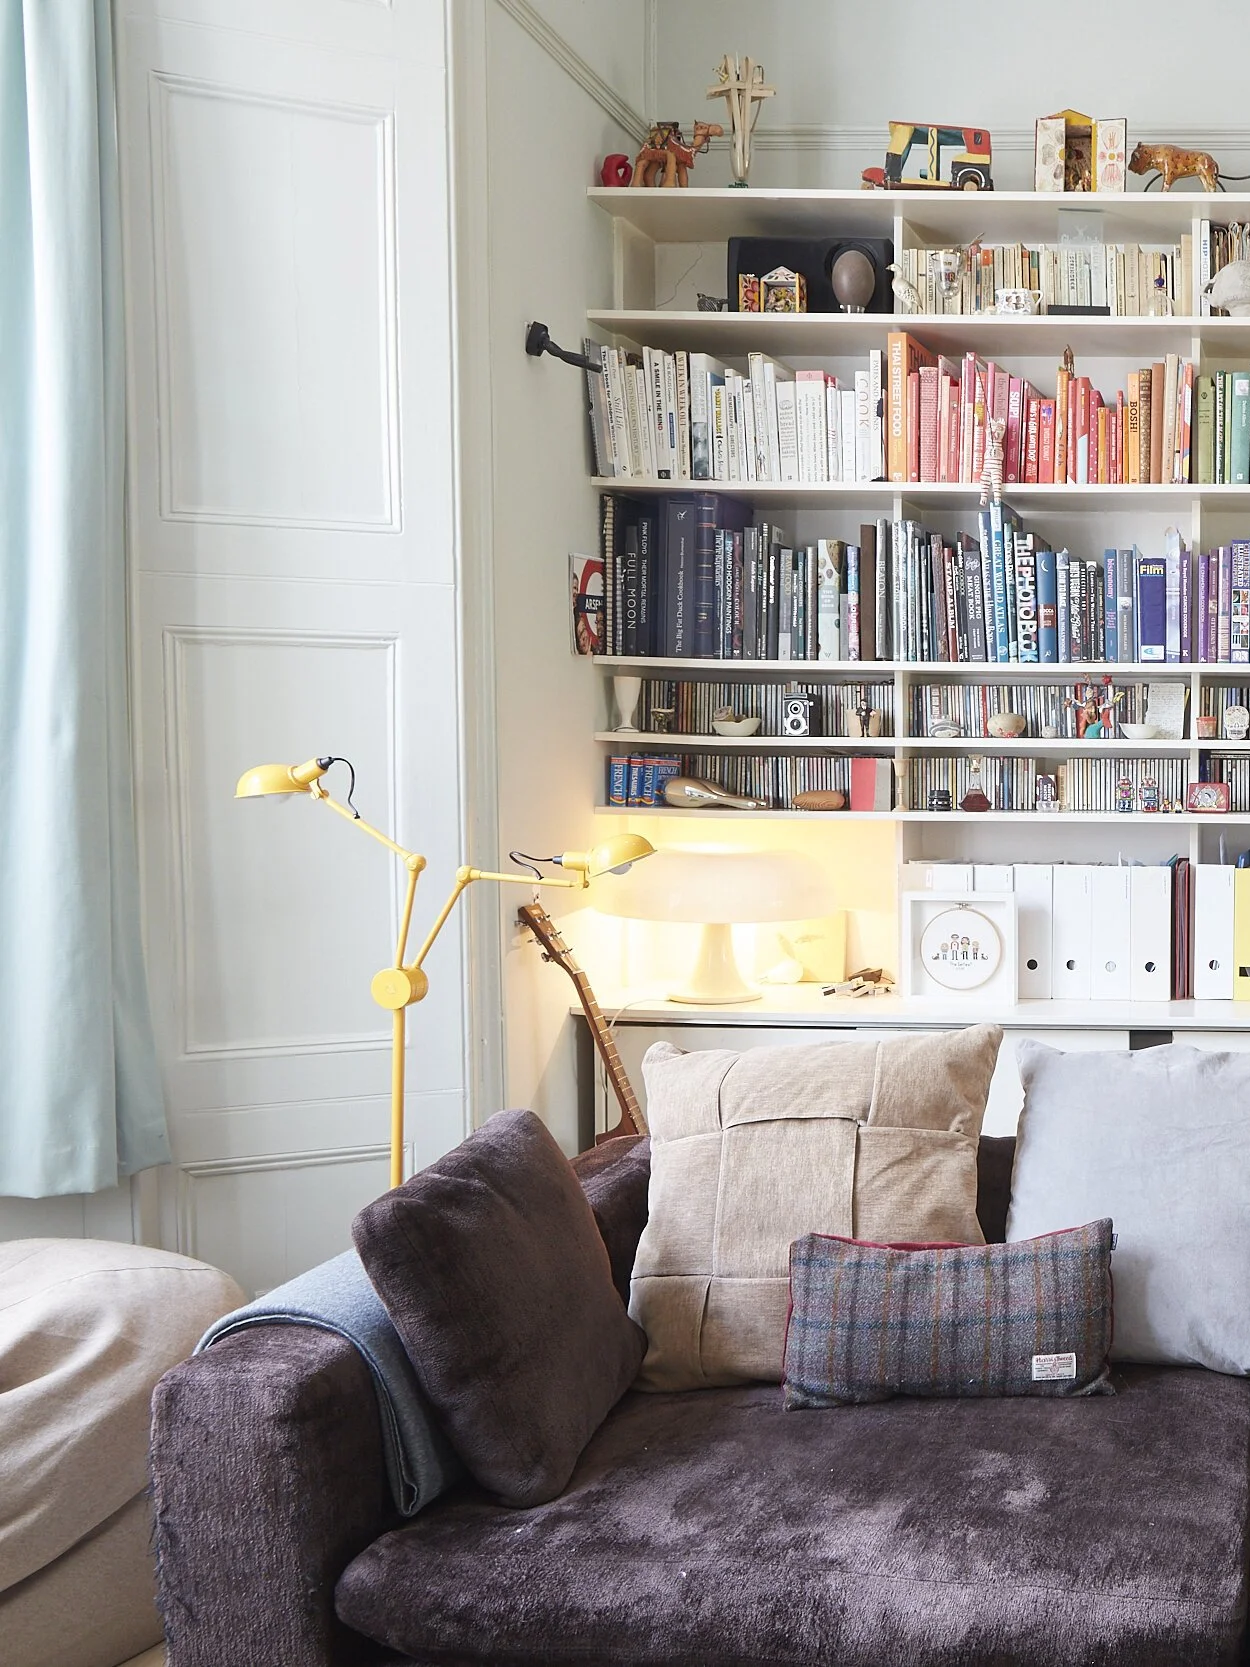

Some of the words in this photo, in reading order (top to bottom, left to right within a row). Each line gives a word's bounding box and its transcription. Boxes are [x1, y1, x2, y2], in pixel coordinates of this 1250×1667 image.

[892, 340, 902, 366] THAI
[653, 368, 661, 389] SMILE
[892, 367, 902, 407] STREET
[997, 377, 1006, 391] the
[655, 390, 662, 398] IN
[858, 378, 869, 428] COOK
[996, 392, 1006, 417] whole
[1009, 391, 1020, 419] SOUP!
[606, 400, 614, 424] children
[656, 413, 664, 431] MIND
[679, 411, 687, 427] OUT
[892, 408, 902, 437] FOOD
[1129, 401, 1138, 433] BOSH!
[626, 552, 636, 582] FULL
[725, 540, 733, 569] HOWARD
[784, 554, 792, 571] RAW
[982, 558, 992, 576] ATLAS
[993, 539, 1002, 571] GREAT
[878, 560, 886, 598] BEATON
[945, 562, 953, 596] STAMP
[958, 568, 966, 597] COOKBOOK
[1106, 558, 1115, 599] bistronomy
[1139, 564, 1164, 575] Film
[725, 570, 733, 601] HODGKIN
[784, 572, 792, 596] FOOD
[966, 575, 974, 597] MEAT
[973, 575, 981, 605] GINGER
[994, 572, 1003, 605] WORLD
[626, 588, 637, 630] MOON
[947, 597, 955, 629] ALBUM
[967, 598, 975, 620] BOOK
[974, 606, 982, 620] PIG
[985, 600, 994, 624] HUMAN
[996, 605, 1005, 633] ATLAS
[675, 628, 683, 639] Big
[986, 625, 995, 644] BODY
[613, 764, 624, 796] FRENCH
[643, 765, 654, 797] FRENCH
